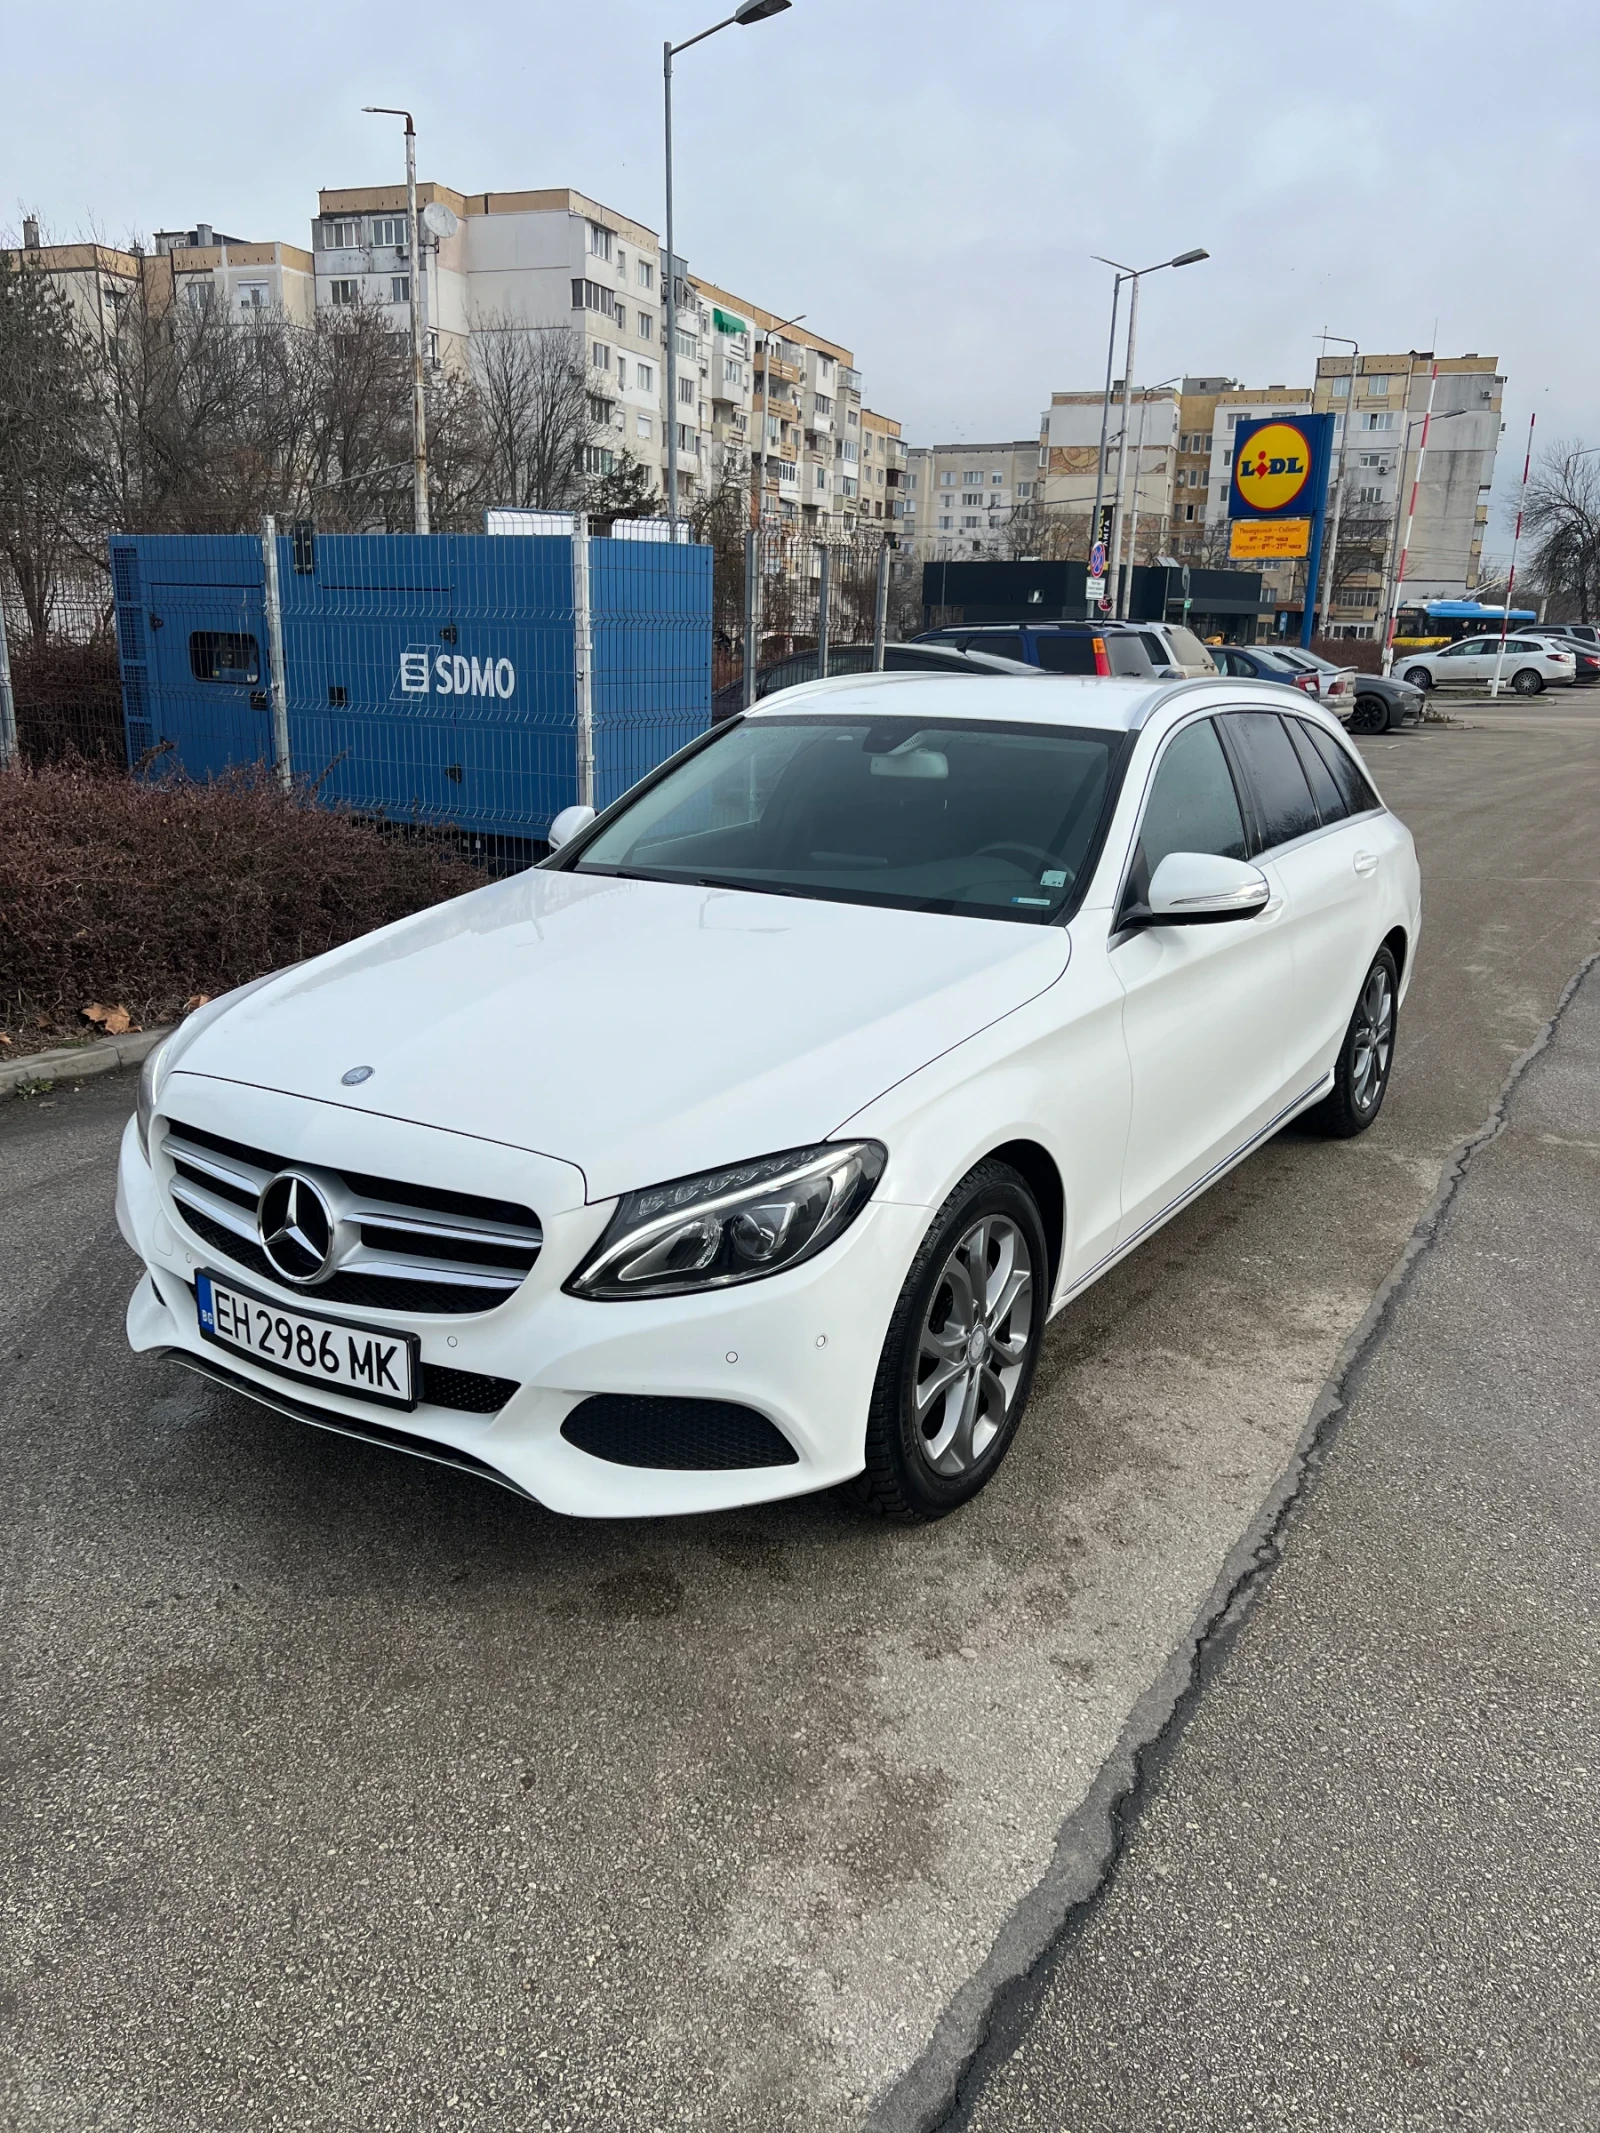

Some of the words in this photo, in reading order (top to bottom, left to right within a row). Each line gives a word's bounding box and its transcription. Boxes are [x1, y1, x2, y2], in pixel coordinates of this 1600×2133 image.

[436, 654, 515, 699] SDMO
[201, 1309, 214, 1325] BG
[215, 1289, 251, 1345] EH
[256, 1309, 340, 1374] 2986
[348, 1336, 401, 1391] MK
